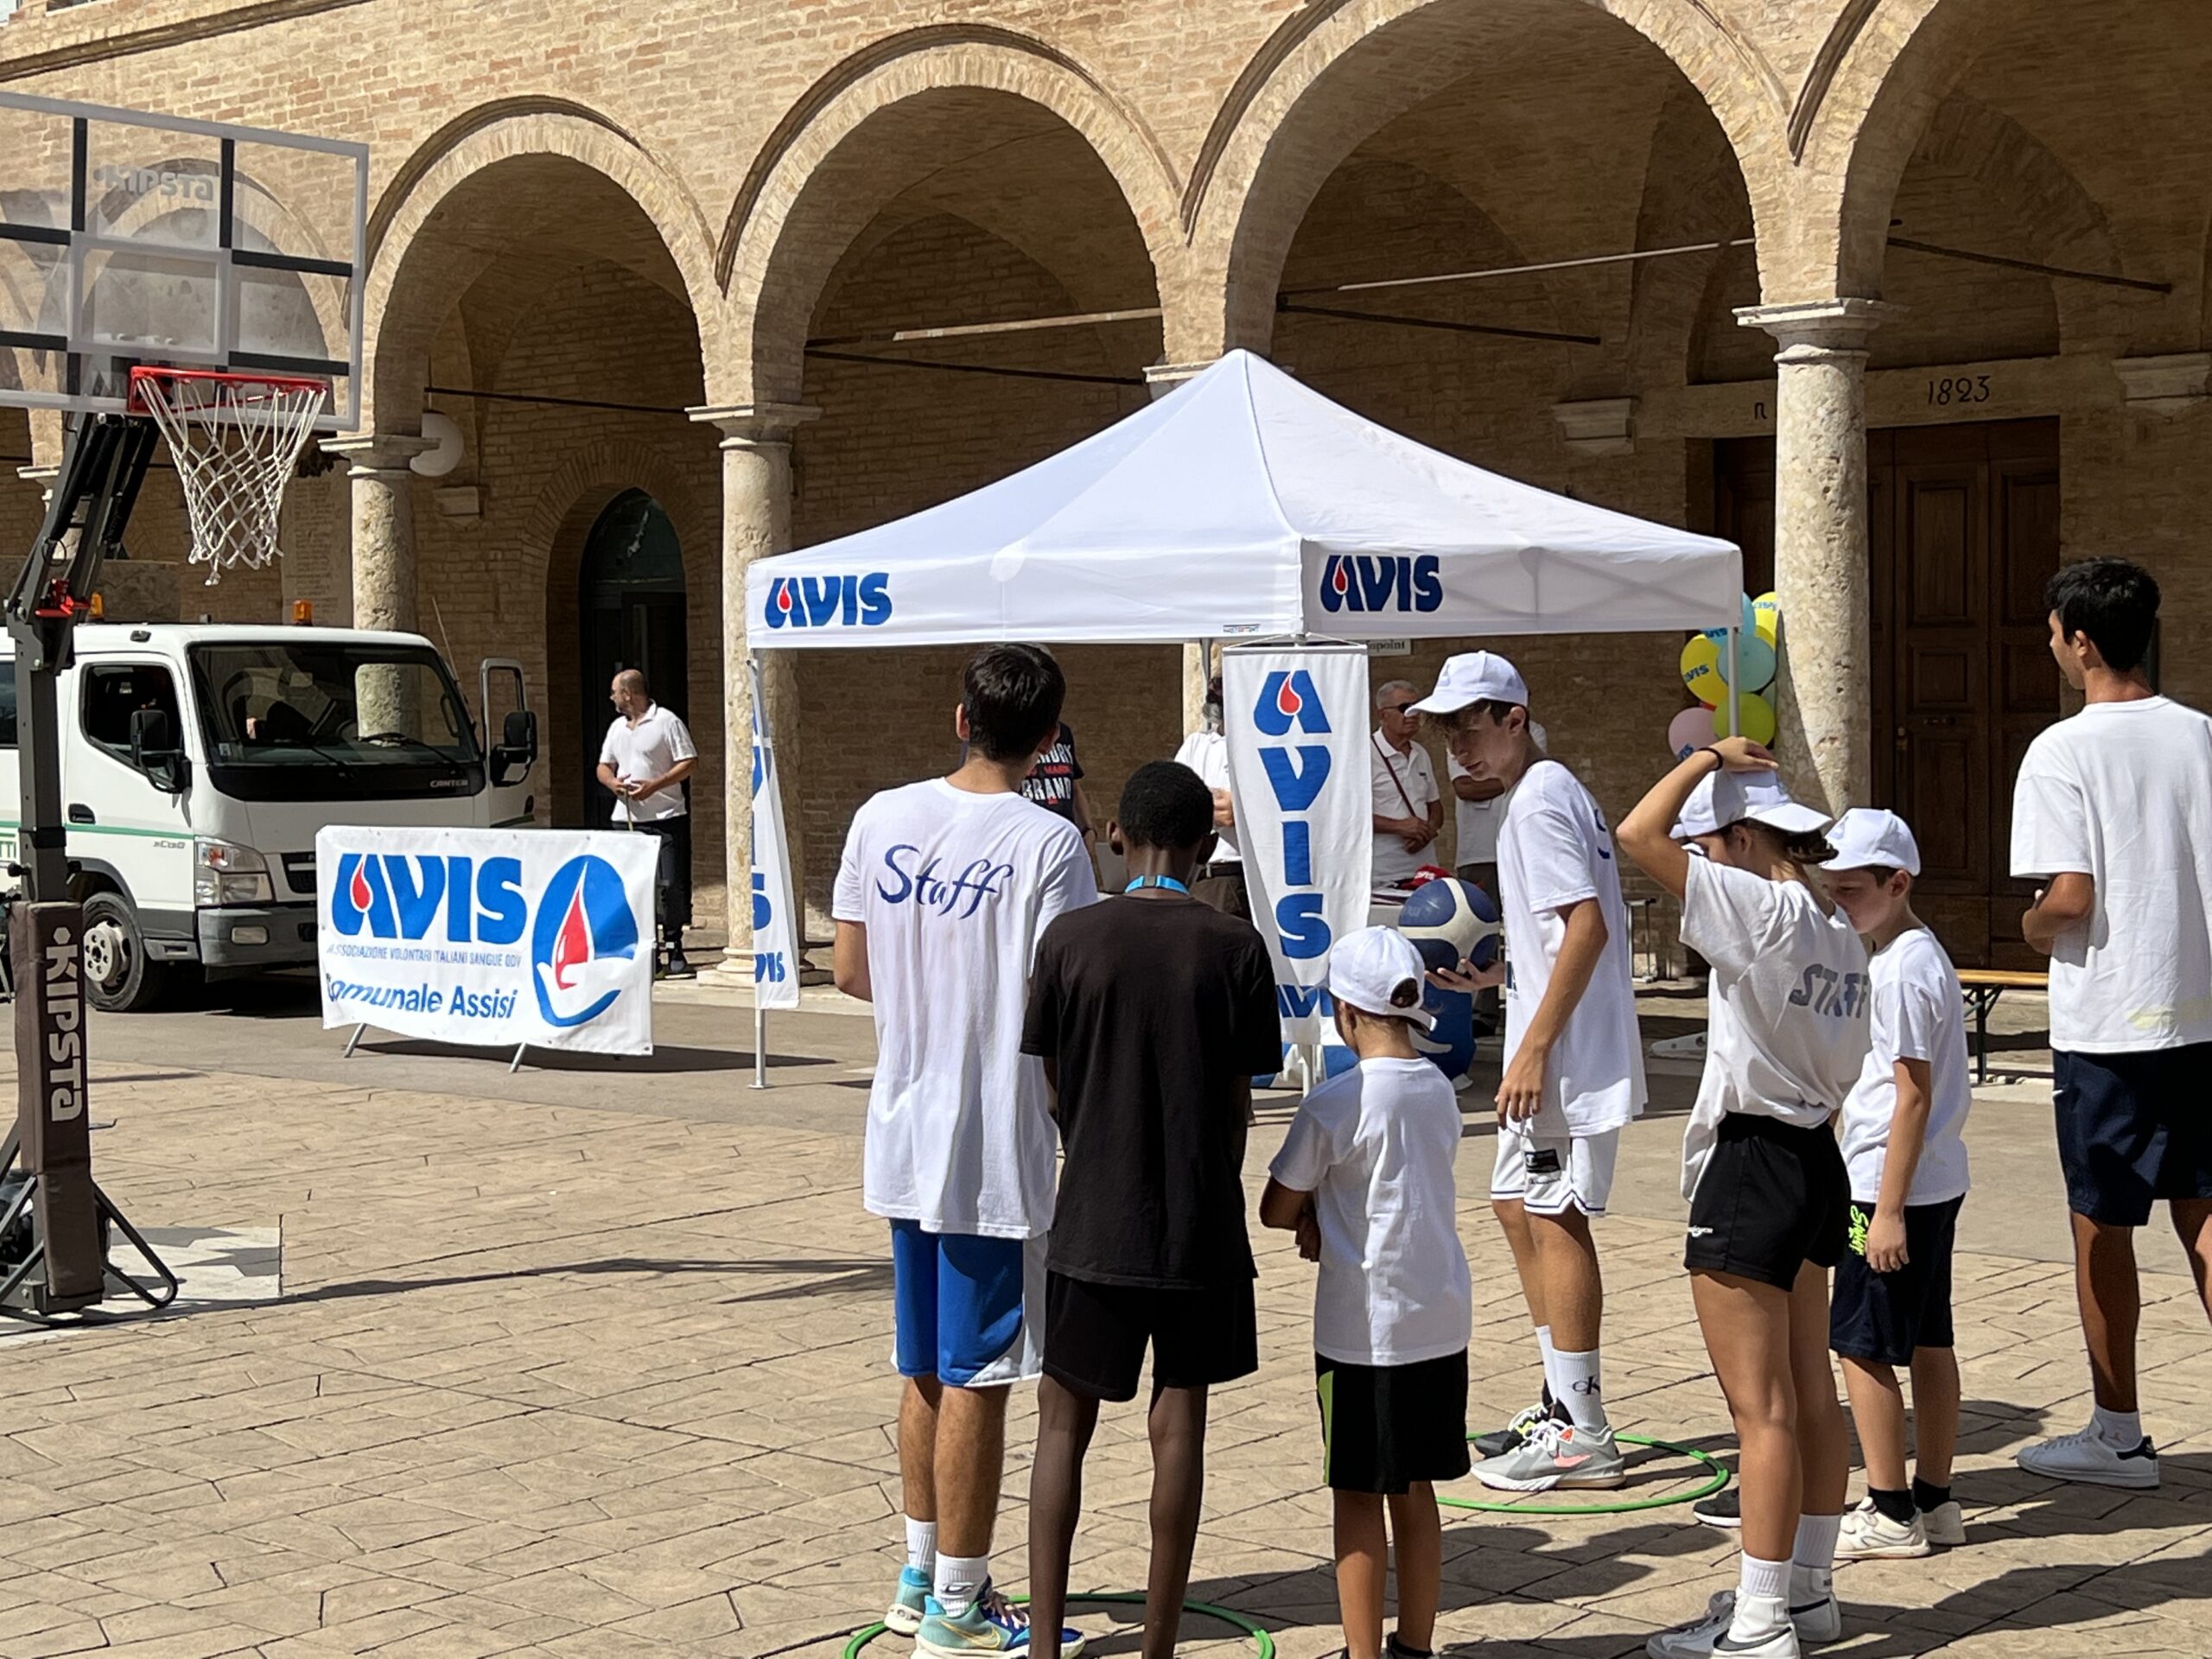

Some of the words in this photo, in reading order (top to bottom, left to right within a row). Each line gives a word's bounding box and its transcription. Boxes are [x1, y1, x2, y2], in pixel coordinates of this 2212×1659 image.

[1928, 375, 1992, 406] 1823
[765, 572, 893, 629] AVIS
[1320, 554, 1443, 613] AVIS
[1254, 670, 1332, 960] AVIS
[332, 854, 527, 945] AVIS
[876, 844, 1014, 919] Staff
[390, 947, 431, 962] VOLONTARI
[434, 950, 467, 963] ITALIANI
[469, 952, 503, 967] SANGUE
[448, 985, 518, 1019] Assisi
